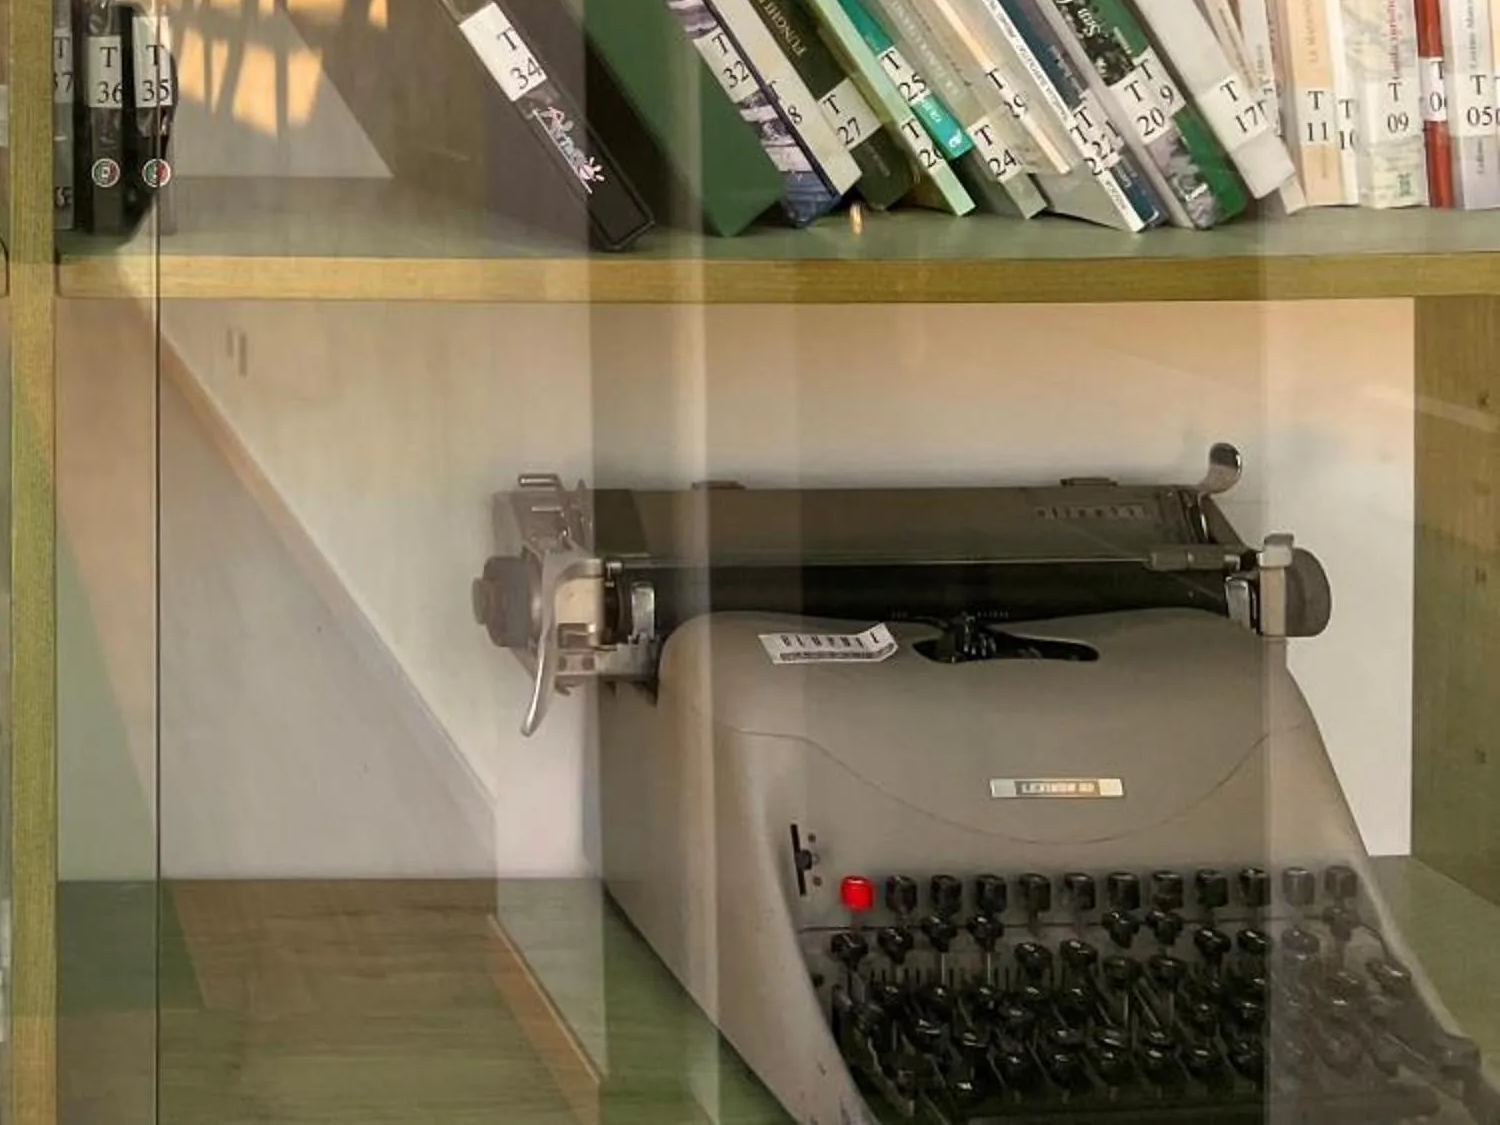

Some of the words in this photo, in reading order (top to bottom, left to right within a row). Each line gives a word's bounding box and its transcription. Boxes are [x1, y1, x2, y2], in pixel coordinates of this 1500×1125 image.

[100, 46, 117, 68] T
[98, 82, 123, 103] 36
[1387, 112, 1409, 132] 09
